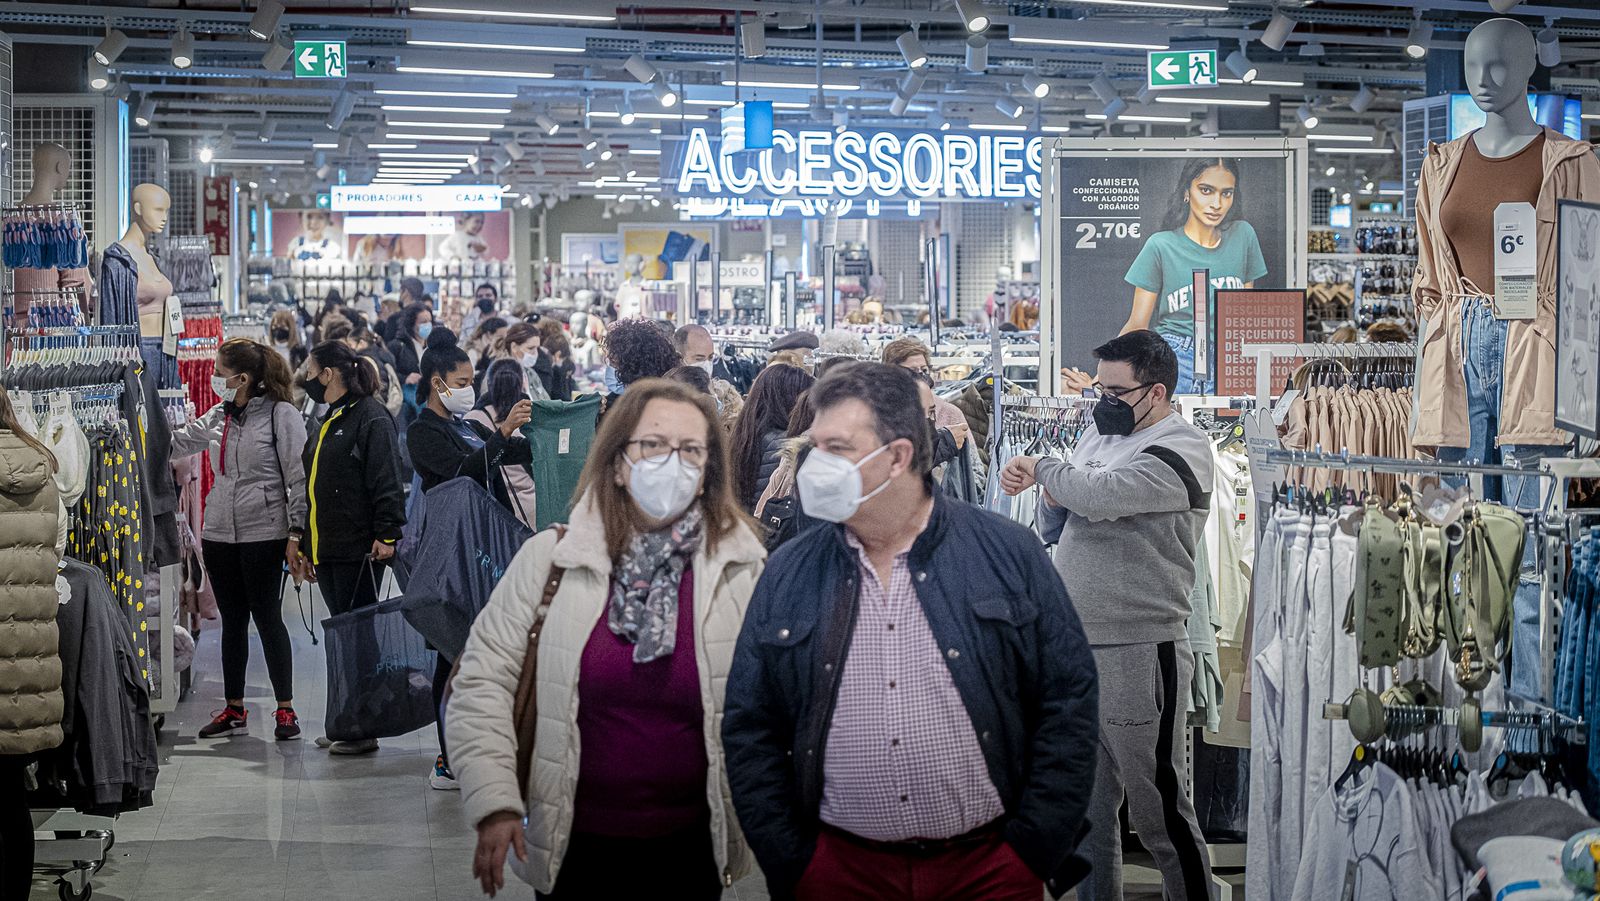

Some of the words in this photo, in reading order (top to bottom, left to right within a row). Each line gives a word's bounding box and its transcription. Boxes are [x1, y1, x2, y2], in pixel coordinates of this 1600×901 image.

[1089, 178, 1140, 186] CAMISETA
[347, 193, 423, 202] PROBADORES
[455, 193, 485, 202] CAJA
[1075, 222, 1141, 249] 2.70€
[1500, 235, 1525, 255] 6€
[718, 266, 760, 278] OSTRO
[1225, 305, 1295, 316] DESCUENTOS
[1225, 317, 1295, 328] DESCUENTOS
[1225, 329, 1295, 340] DESCUENTOS
